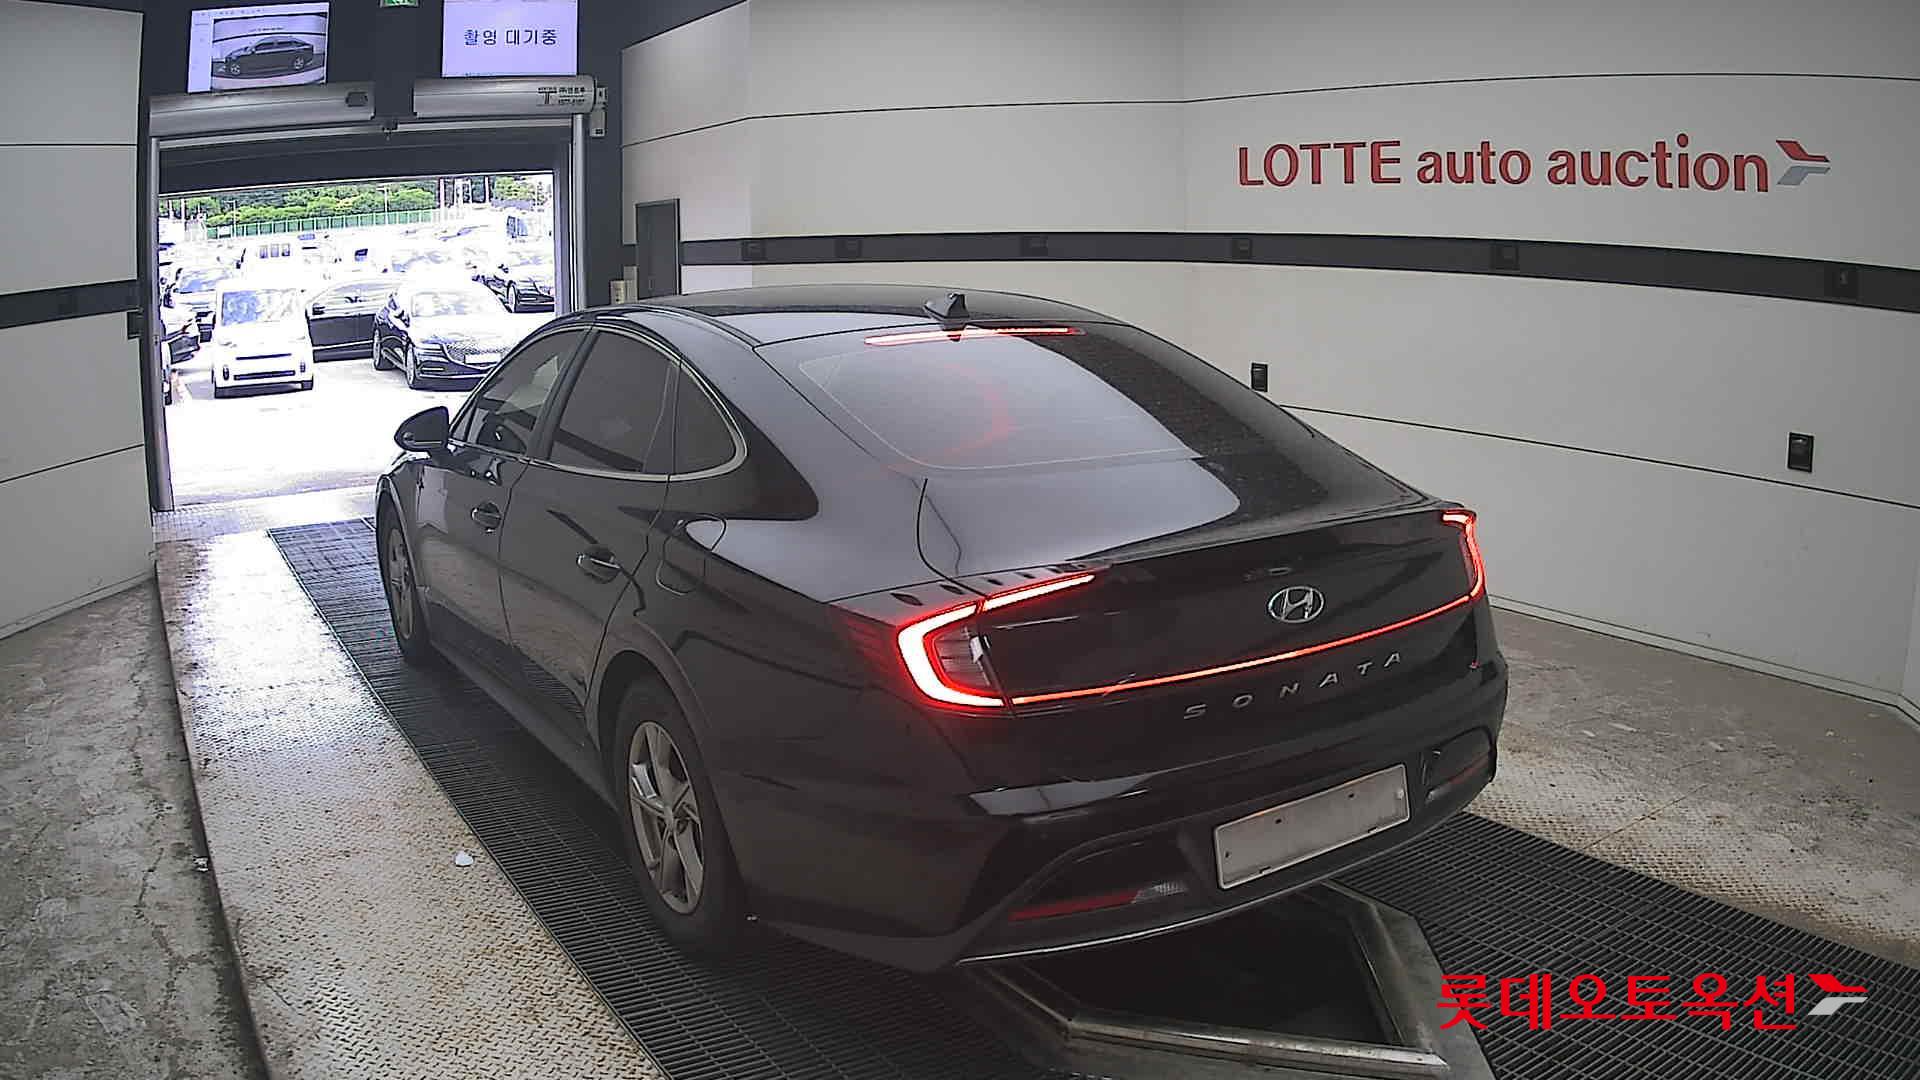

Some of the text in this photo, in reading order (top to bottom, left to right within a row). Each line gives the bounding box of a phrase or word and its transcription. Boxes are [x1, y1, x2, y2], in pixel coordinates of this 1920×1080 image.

[506, 29, 558, 46] 대기중
[1239, 133, 1769, 192] LOTTE auto auction
[1184, 652, 1401, 719] SONATA
